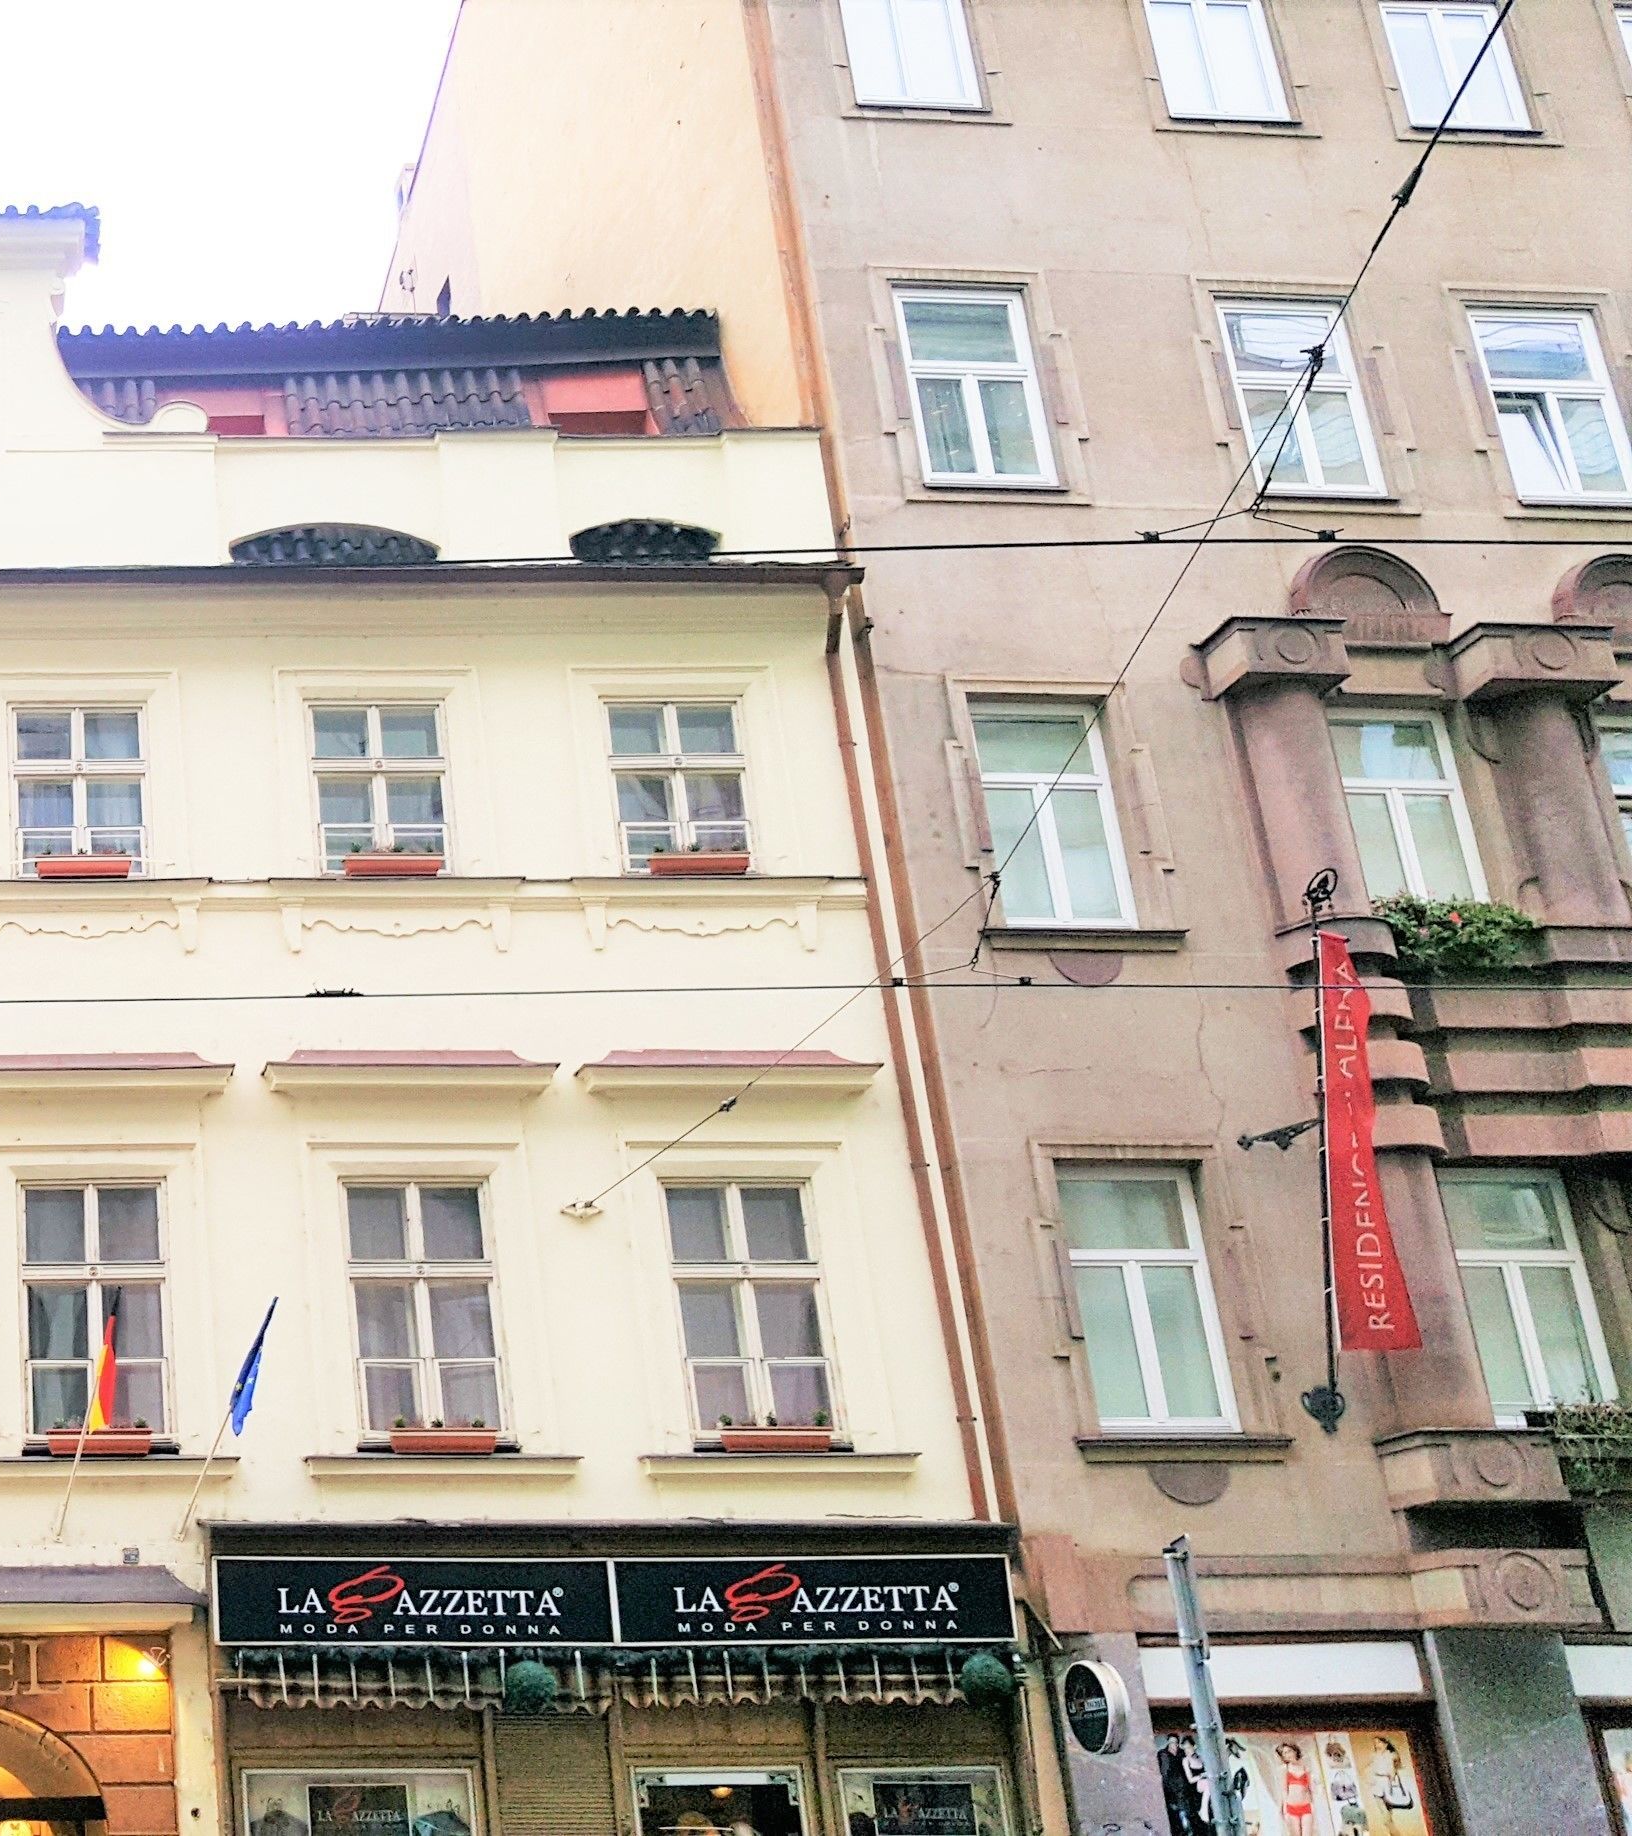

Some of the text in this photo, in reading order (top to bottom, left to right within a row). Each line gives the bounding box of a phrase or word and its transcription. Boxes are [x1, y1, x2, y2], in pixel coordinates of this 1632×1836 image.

[277, 1587, 326, 1613] LA
[673, 1586, 723, 1612] LA
[280, 1623, 561, 1635] MODA PER DONNA
[677, 1619, 958, 1633] MODA PER DONNA
